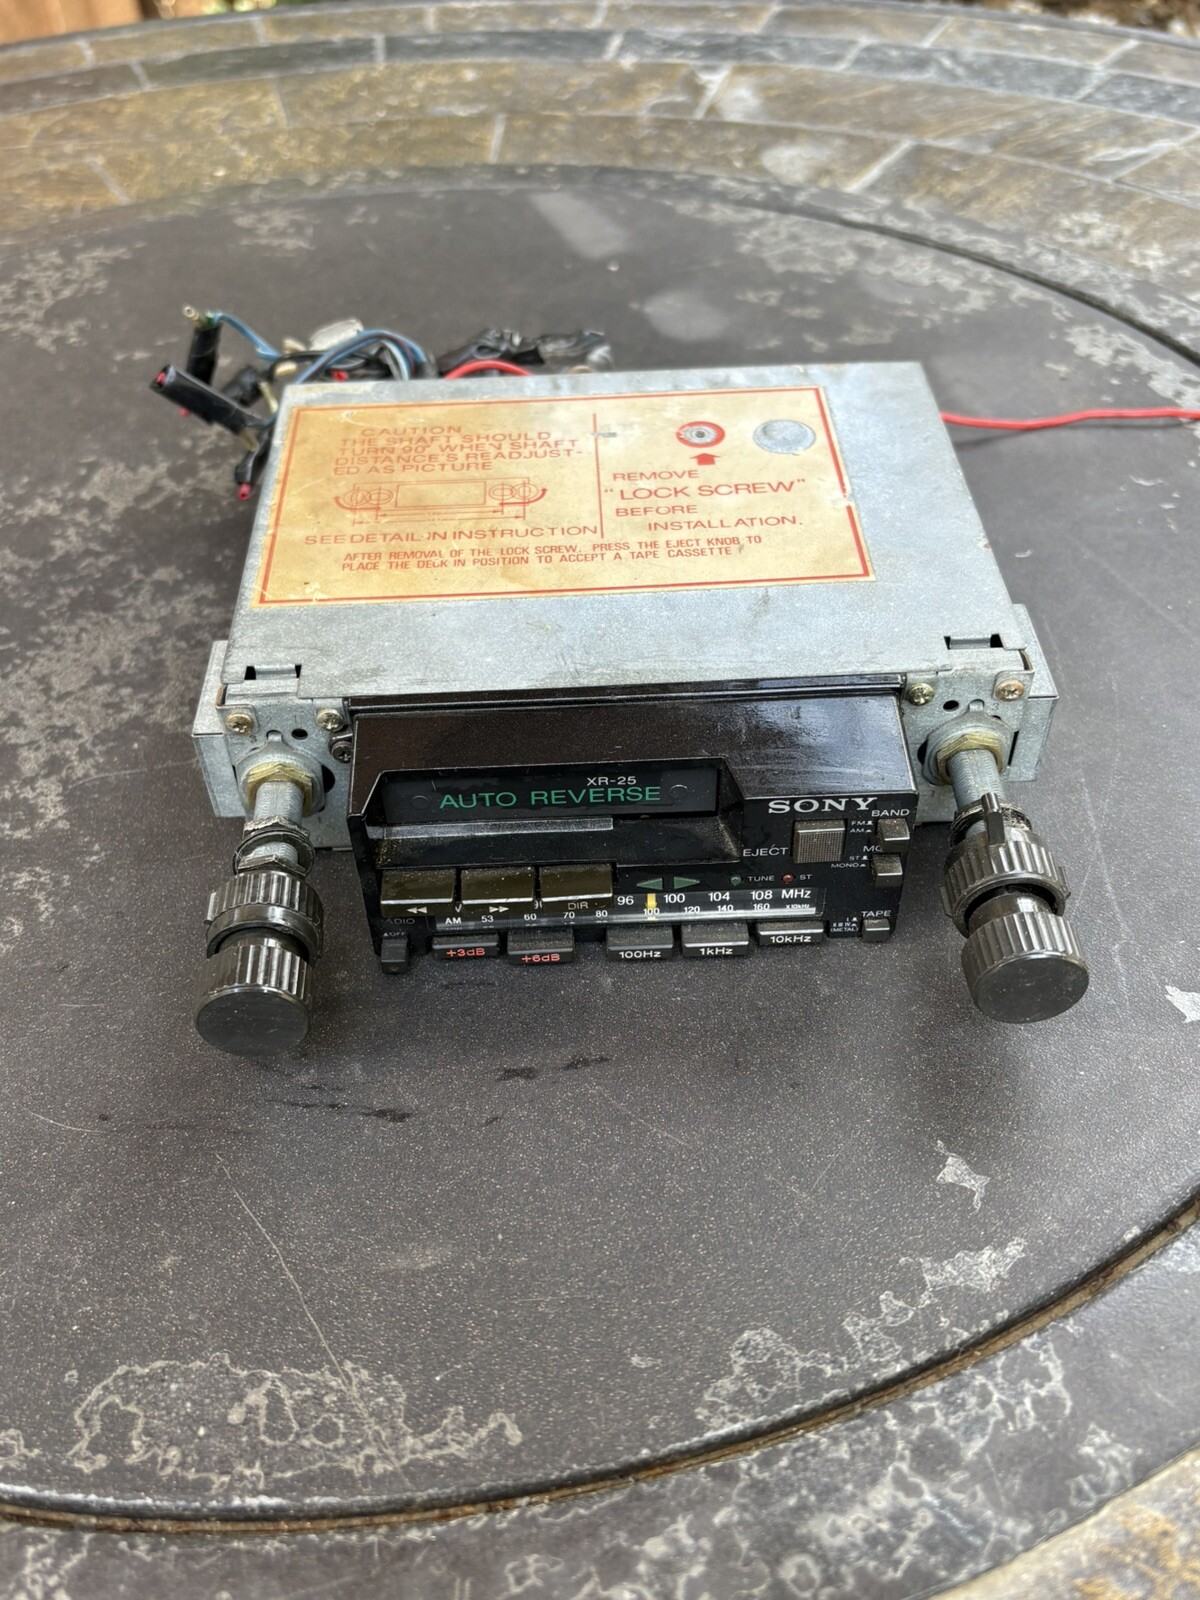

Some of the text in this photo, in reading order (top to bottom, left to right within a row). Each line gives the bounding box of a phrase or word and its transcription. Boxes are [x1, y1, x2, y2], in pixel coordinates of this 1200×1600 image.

[361, 425, 462, 437] CAUTION
[340, 431, 551, 447] THE SHAFT SHOULD
[339, 446, 396, 456] TURN
[438, 442, 502, 453] WHEN
[510, 438, 579, 450] SHAFT
[465, 448, 583, 461] READJUST-
[333, 461, 493, 476] ED AS PICTURE
[613, 469, 699, 482] REMOVE
[616, 504, 698, 517] BEFORE
[648, 515, 803, 532] INSTALLATION.
[350, 532, 421, 544] DETAIL
[452, 525, 598, 540] INSTRUCTION
[344, 552, 382, 562] AFTER
[389, 549, 444, 560] REMOVAL
[450, 549, 464, 558] OF
[470, 548, 491, 557] THE
[500, 546, 529, 556] LOCK
[592, 542, 630, 551] PRESS
[638, 541, 660, 550] THE
[665, 538, 701, 548] EJECT
[706, 537, 740, 547] KNOB
[745, 535, 762, 544] TO
[342, 546, 732, 571] PLACE THE DECK IN POSITION TO ACCEPT A TAPE CASSETTE
[586, 776, 637, 786] XR-25
[439, 786, 661, 809] AUTO REVERSE
[768, 798, 877, 814] SONY
[871, 808, 910, 817] BAND
[743, 847, 789, 857] EJECT
[617, 895, 634, 906] 96
[663, 893, 686, 904] 100
[708, 891, 731, 902] 104
[751, 889, 773, 900] 108
[781, 888, 811, 899] MHz
[567, 901, 589, 910] DIR
[445, 917, 462, 925] AM
[481, 915, 494, 923] 53
[524, 913, 537, 921] 60
[563, 911, 575, 919] 70
[595, 910, 608, 918] 80
[643, 908, 660, 916] 100
[684, 906, 700, 914] 120
[717, 904, 734, 912] 140
[753, 902, 770, 910] 160
[861, 909, 891, 917] TAPE
[770, 934, 812, 944] 10kHz
[446, 947, 486, 957] +3dB
[619, 950, 662, 960] 100Hz
[700, 946, 733, 956] 1kHz
[521, 953, 561, 963] +6dB
